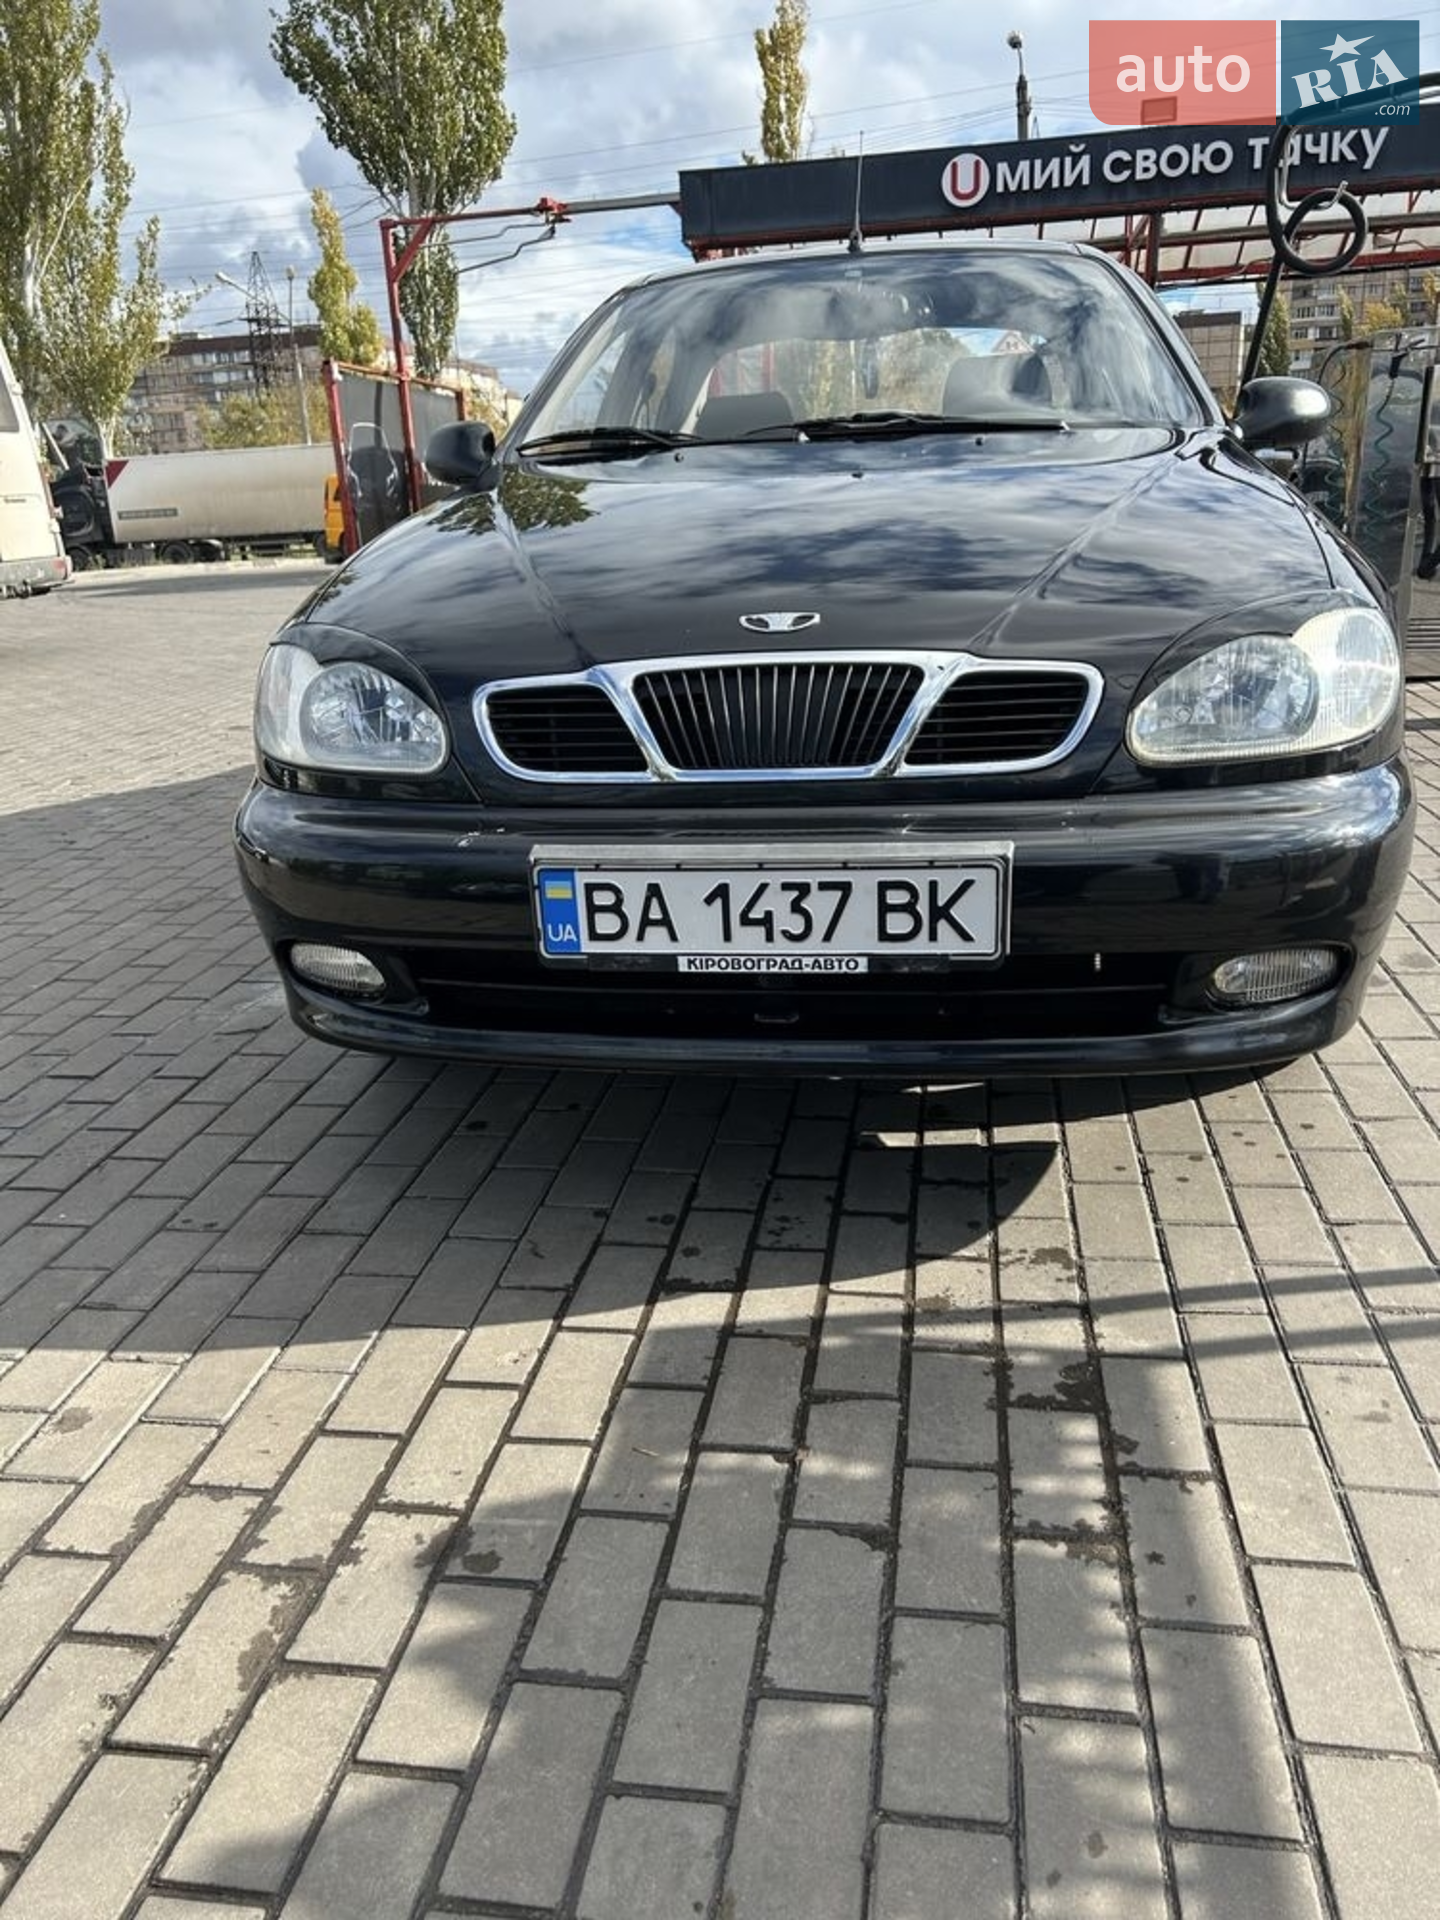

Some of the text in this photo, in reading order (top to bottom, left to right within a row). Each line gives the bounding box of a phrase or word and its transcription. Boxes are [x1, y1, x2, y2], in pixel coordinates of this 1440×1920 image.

[584, 878, 976, 943] BA 1437 BK
[547, 922, 578, 942] UA
[686, 956, 860, 972] КІРОВОГРАД-АВТО
